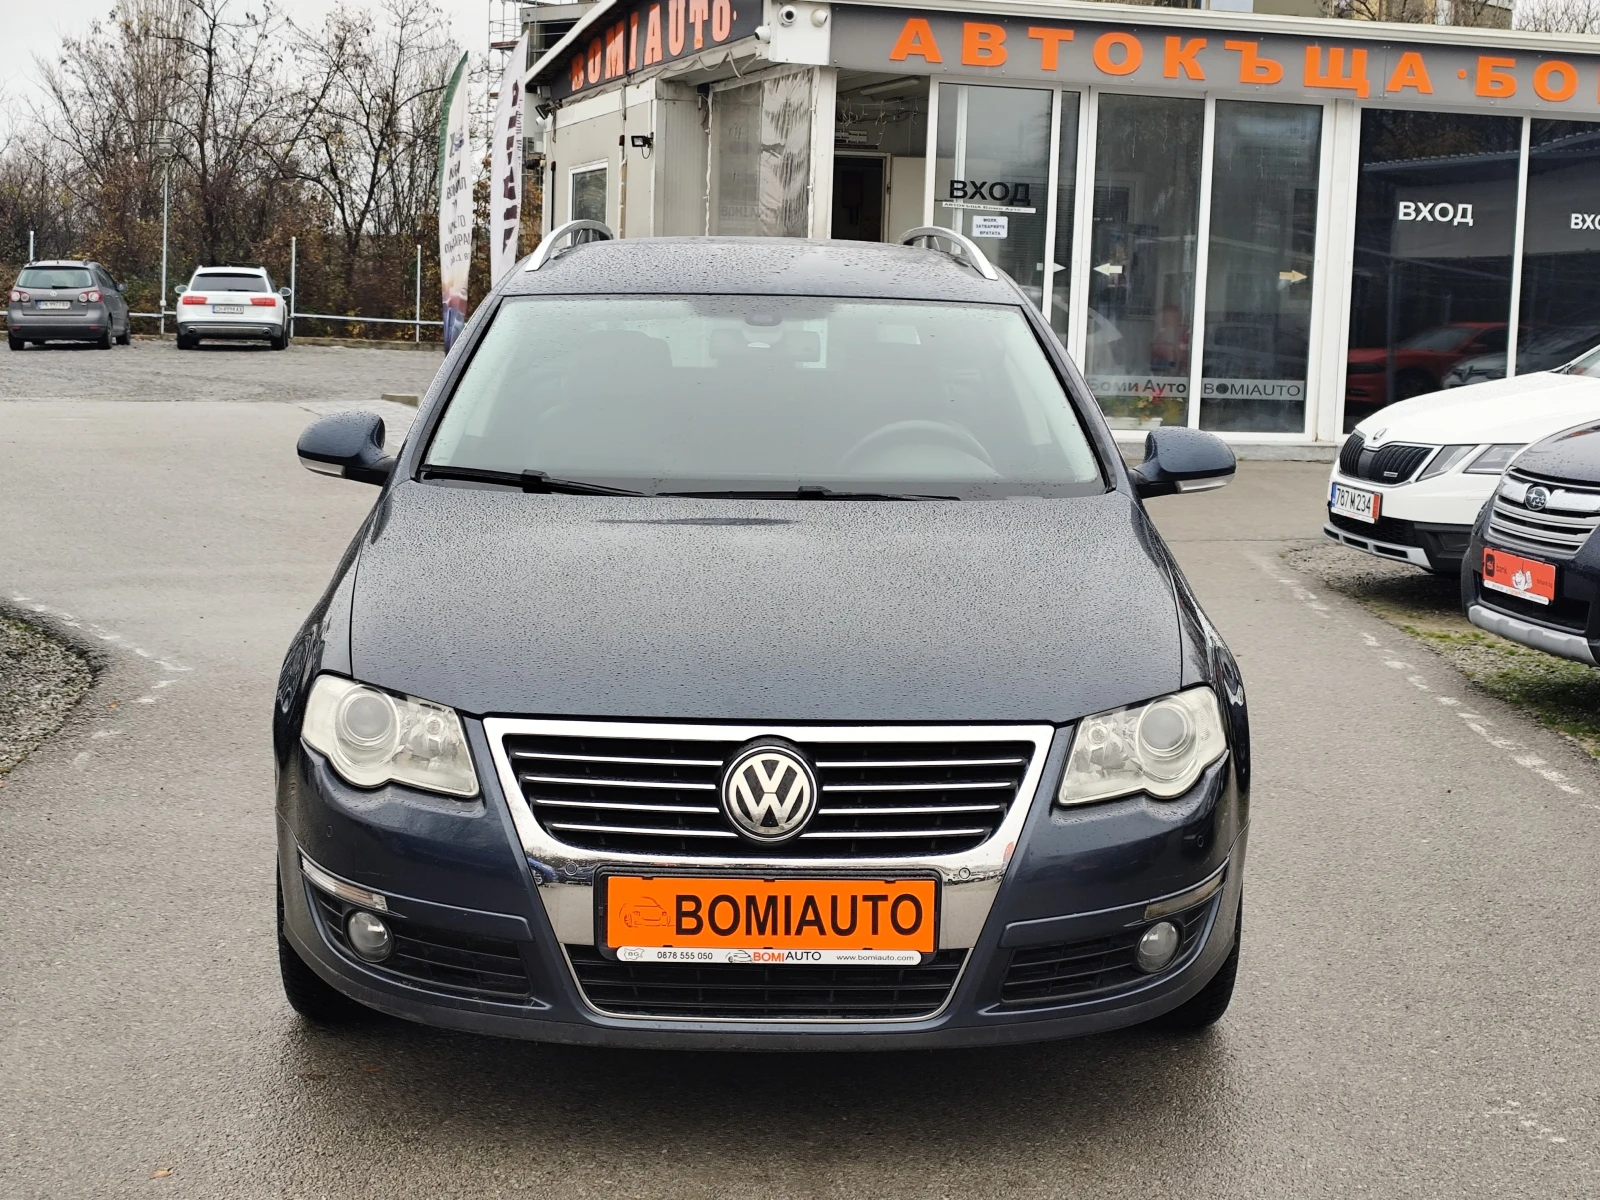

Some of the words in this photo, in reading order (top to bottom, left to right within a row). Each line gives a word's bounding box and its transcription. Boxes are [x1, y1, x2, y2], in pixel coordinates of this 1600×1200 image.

[571, 0, 732, 91] BOMIAUTO
[889, 17, 1434, 99] АВТОКЪЩА
[1475, 55, 1600, 104] БО
[949, 179, 1031, 206] ВХОД
[1398, 201, 1474, 227] ВХОД
[1142, 379, 1187, 396] Ауто
[1203, 382, 1301, 397] BOMIAUTO
[675, 893, 923, 937] BOMIAUTO
[656, 951, 678, 960] 0878
[679, 951, 696, 960] 555
[697, 952, 713, 960] 050
[836, 954, 914, 962] www.bomiauto.com
